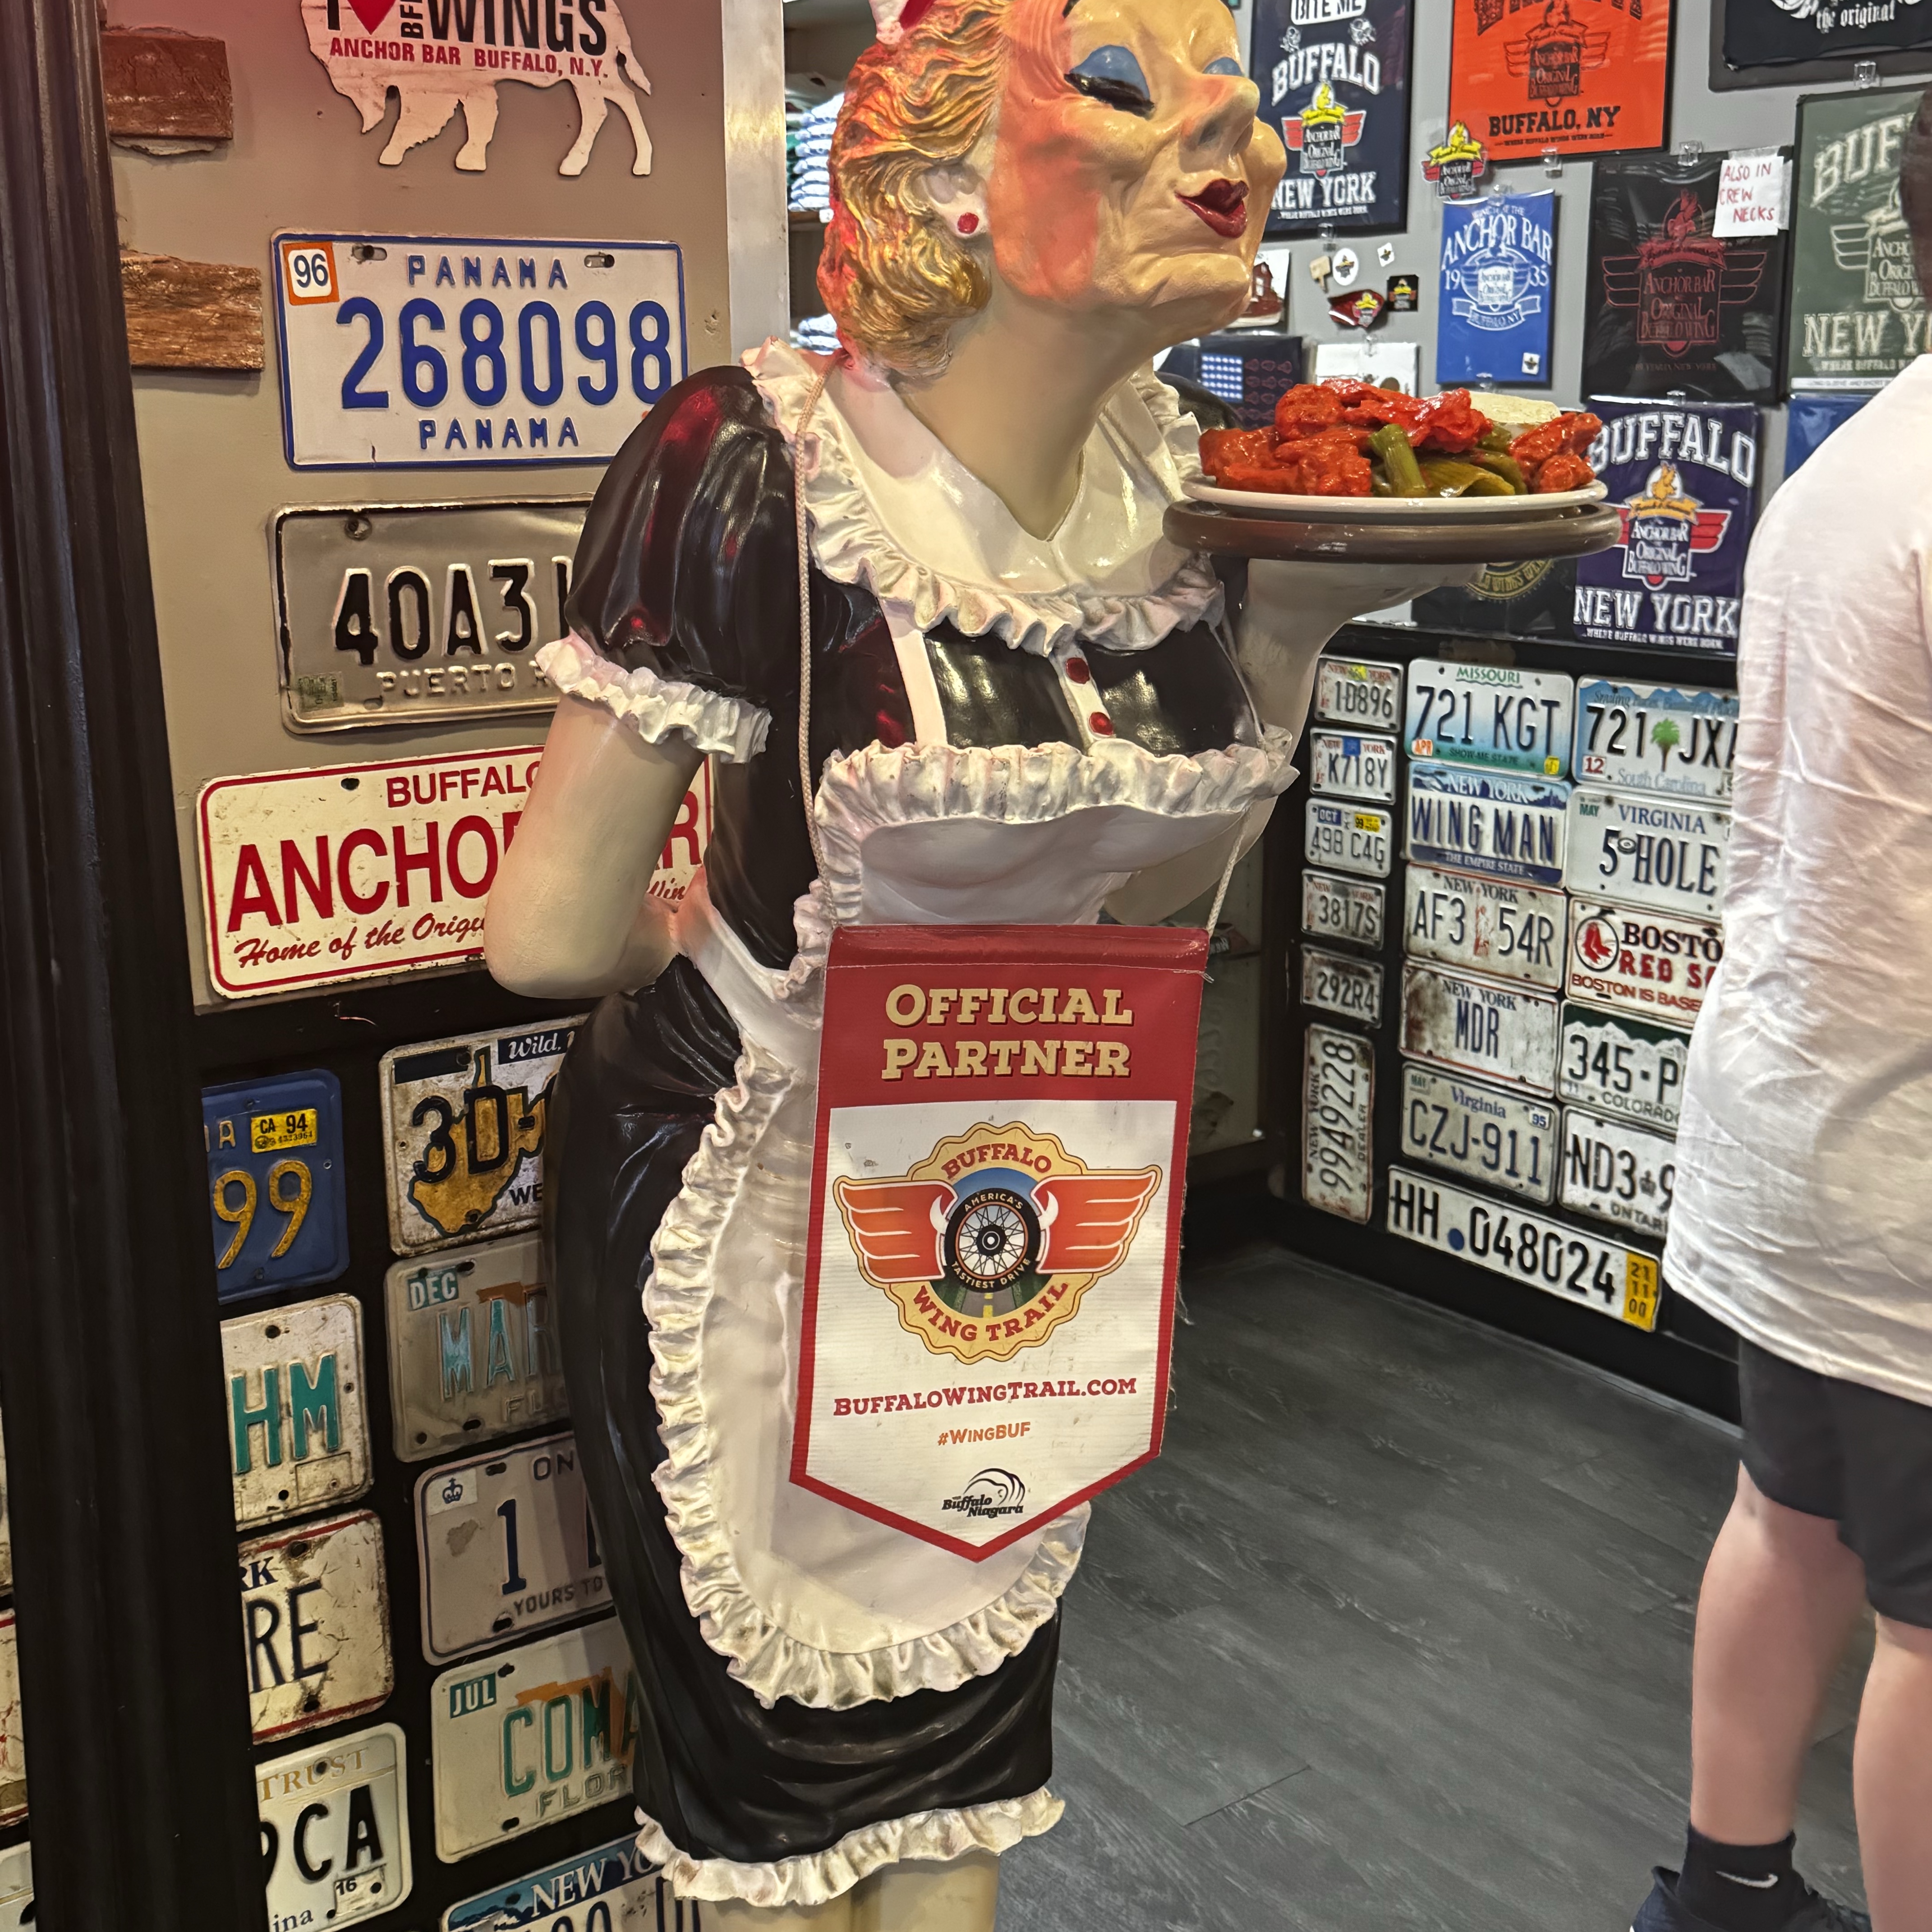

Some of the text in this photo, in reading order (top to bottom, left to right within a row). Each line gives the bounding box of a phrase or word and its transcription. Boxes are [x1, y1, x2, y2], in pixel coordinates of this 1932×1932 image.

[1840, 0, 1895, 29] original
[330, 37, 608, 78] ANCHOR BAR BUFFALO, N.Y.
[1271, 42, 1380, 107] BUFFALO
[1587, 106, 1621, 128] NY
[1723, 162, 1771, 181] ALSO IN
[1810, 112, 1915, 207] BUF
[1271, 171, 1377, 210] NEW YORK
[1719, 187, 1753, 205] CREW
[1733, 206, 1775, 223] NECKS
[1441, 213, 1553, 271] ANCHOR BAR
[293, 254, 328, 290] 96
[408, 254, 568, 289] PANAMA
[1445, 269, 1461, 290] 19
[1802, 310, 1890, 358] NEW
[336, 297, 672, 409] 268098
[419, 417, 579, 450] PANAMA
[1588, 411, 1757, 488] BUFFALO
[1573, 585, 1739, 638] NEW YORK
[377, 662, 517, 697] PUERTO
[1457, 667, 1520, 684] MISSOURI
[1412, 685, 1560, 756] 721 KGT
[1586, 704, 1647, 759] 721
[1328, 752, 1388, 788] K718Y
[1492, 751, 1519, 765] STATE
[1584, 756, 1605, 774] 12
[1447, 773, 1528, 805] NEW YORK
[1618, 768, 1706, 796] South Carolina
[1320, 809, 1338, 822] OCT
[1579, 803, 1600, 817] MAY
[1618, 804, 1707, 835] VIRGINIA
[1311, 825, 1344, 855] 498
[1412, 794, 1554, 864] WING MAN
[1445, 851, 1524, 876] THE EMPIRE STATE
[1632, 832, 1721, 897] HOLE
[1443, 875, 1520, 904] NEW YORK
[1318, 895, 1377, 935] 3817S
[1412, 889, 1553, 968] AF3 54R
[233, 918, 405, 970] Home of the
[1618, 949, 1674, 983] RED
[885, 984, 1133, 1026] OFFICIAL
[1317, 971, 1375, 1015] 292R4
[1442, 979, 1518, 1011] NEW YORK
[1571, 973, 1637, 999] BOSTON
[1639, 987, 1655, 1003] IS
[1455, 998, 1500, 1059] MDR
[881, 1038, 1131, 1080] PARTNER
[1308, 1072, 1320, 1159] NEW YORK
[1450, 1085, 1507, 1119] Virginia
[259, 1113, 308, 1135] CA 94
[1532, 1114, 1547, 1128] 95
[1409, 1099, 1541, 1186] CZJ-911
[940, 1142, 1052, 1181] BUFFALO
[1570, 1133, 1637, 1201] ND3
[212, 1159, 313, 1270] 99
[964, 1192, 1023, 1212] AMERICA'S
[1393, 1178, 1616, 1305] HH 048024
[409, 1272, 457, 1308] DEC
[951, 1258, 1031, 1289] TASTIEST DRIVE
[1631, 1262, 1650, 1283] 21
[1632, 1281, 1650, 1299] 11
[912, 1281, 1069, 1342] WING TRAIL
[1628, 1299, 1647, 1318] 00
[230, 1353, 339, 1475] HM
[942, 1494, 993, 1512] Buffalo
[966, 1504, 1024, 1519] Niagara
[514, 1576, 603, 1616] YOURS TO
[451, 1678, 494, 1716] JUL
[258, 1747, 369, 1802] TRUST
[336, 1877, 357, 1895] 16
[530, 1858, 607, 1918] NEW
